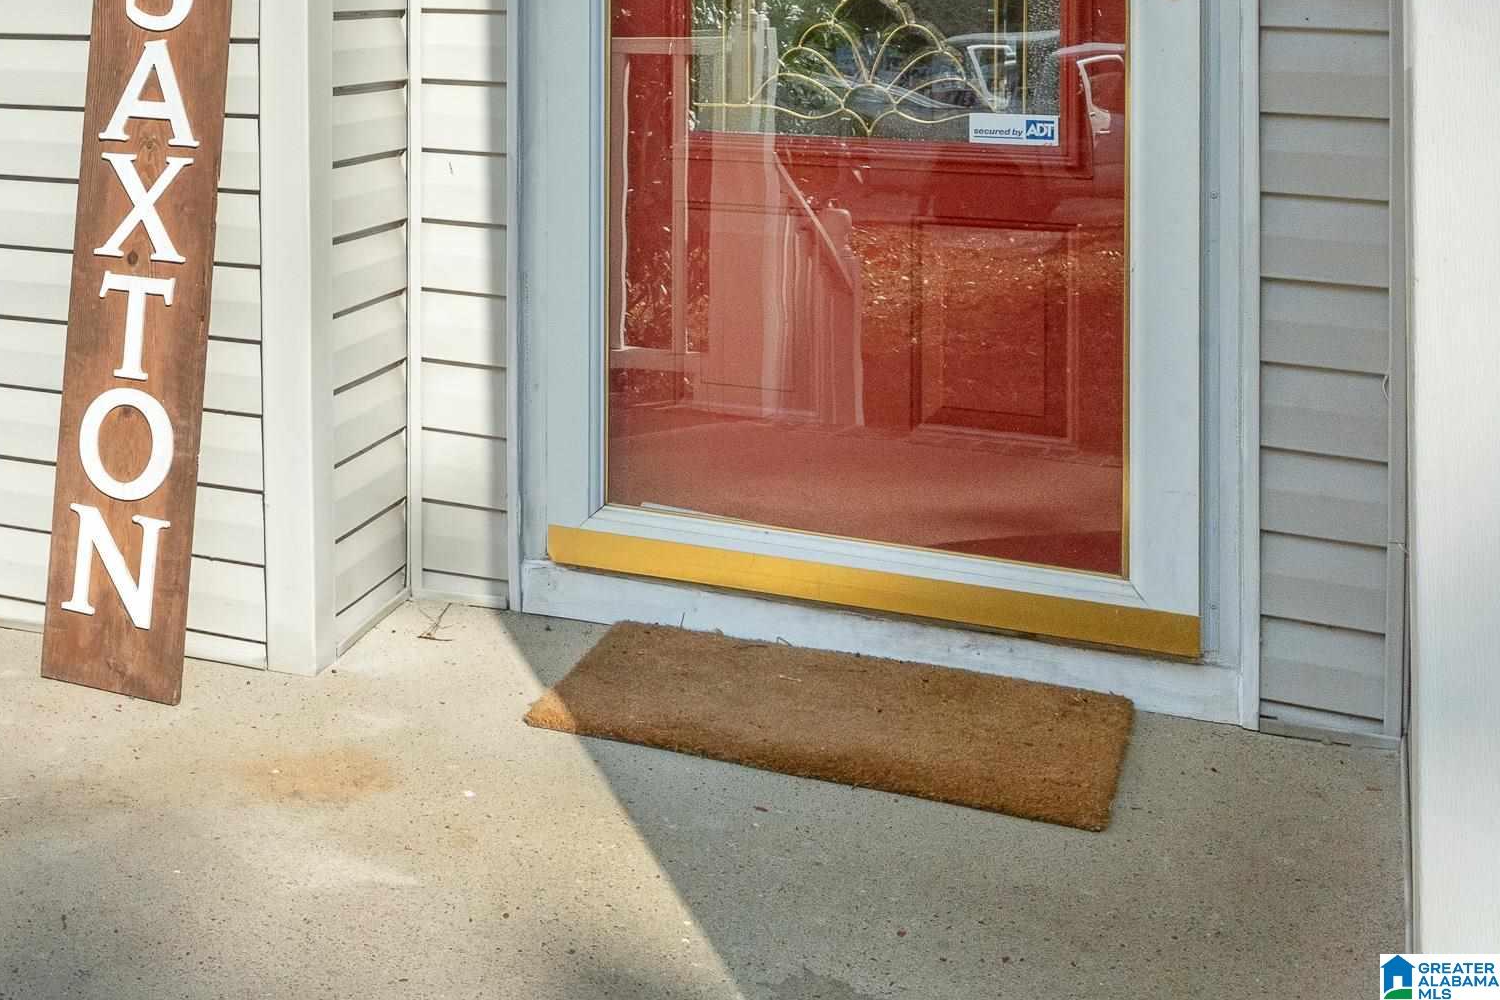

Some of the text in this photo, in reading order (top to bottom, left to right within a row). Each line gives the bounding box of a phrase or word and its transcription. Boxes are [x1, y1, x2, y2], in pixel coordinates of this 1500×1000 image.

[973, 123, 1054, 137] secured by ADT
